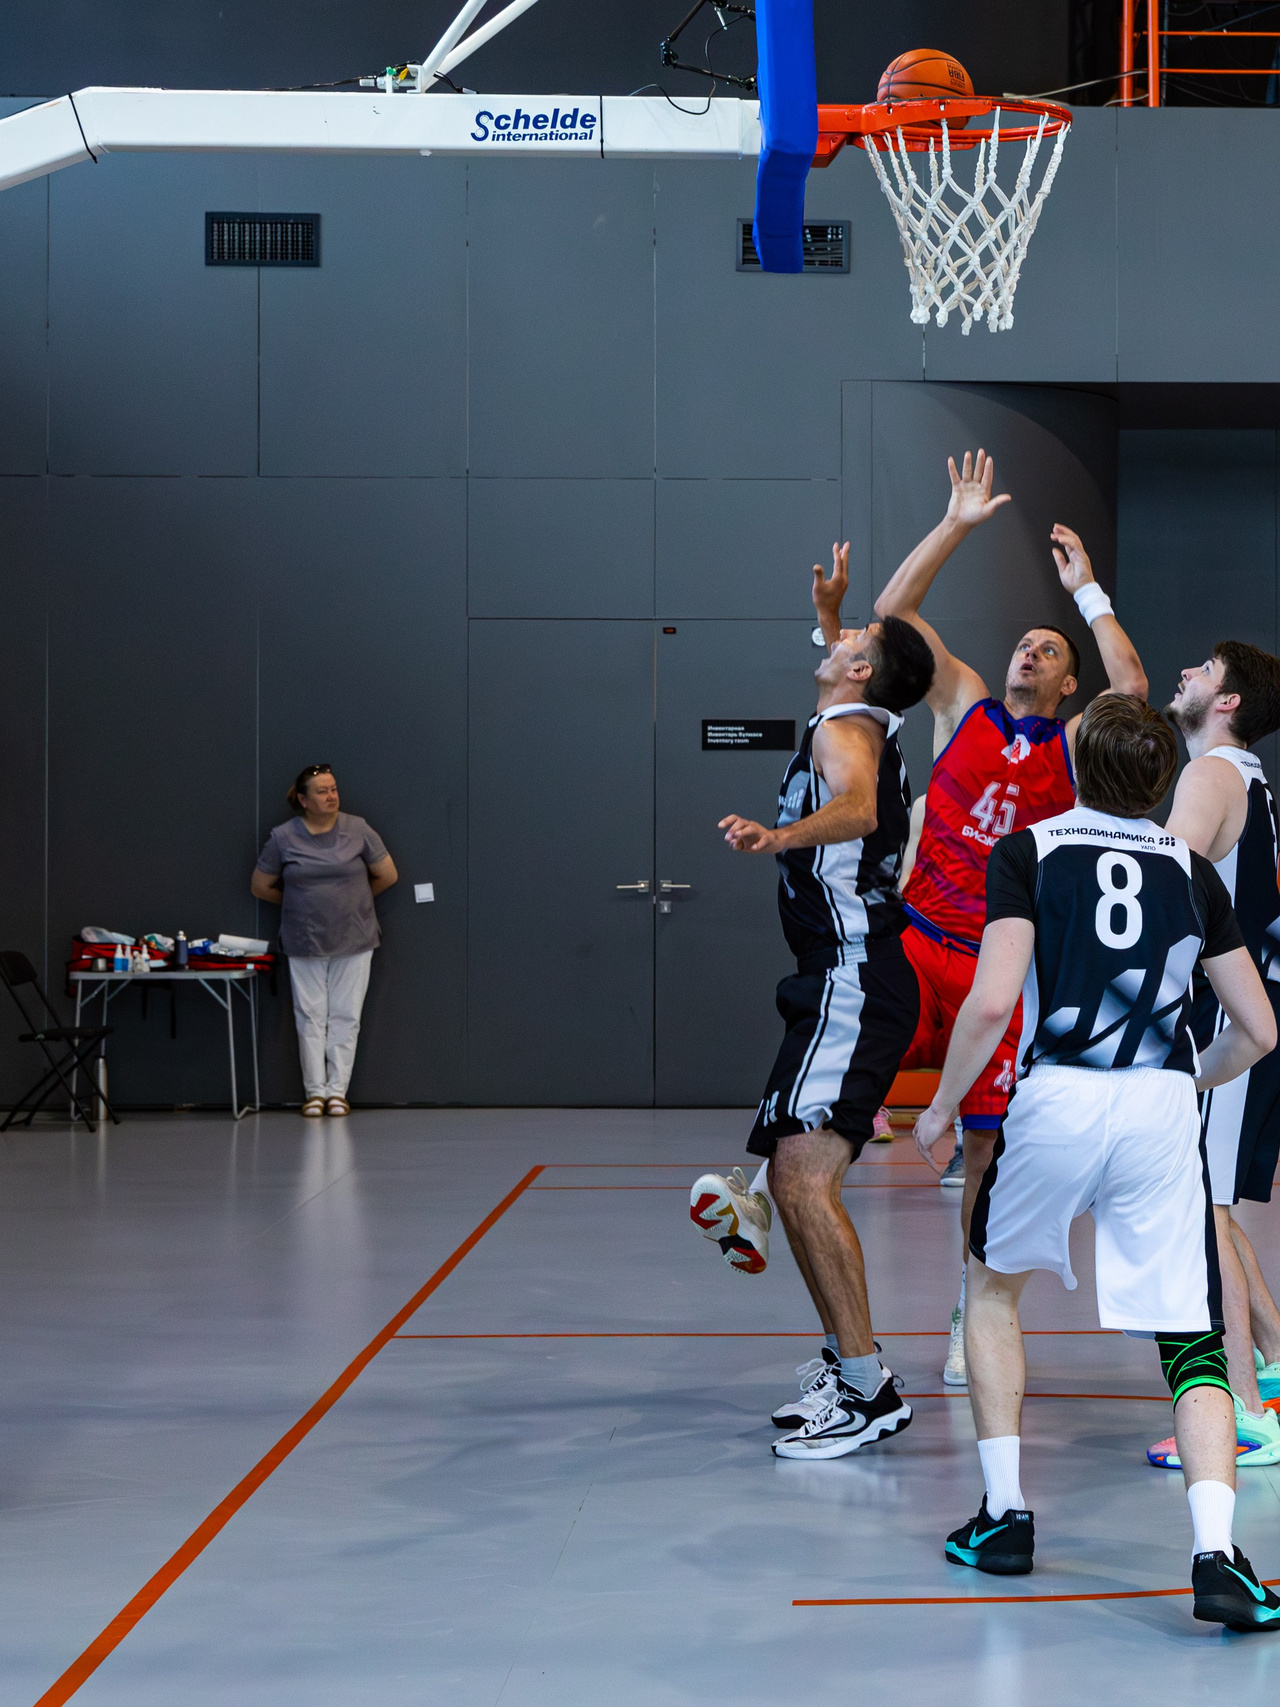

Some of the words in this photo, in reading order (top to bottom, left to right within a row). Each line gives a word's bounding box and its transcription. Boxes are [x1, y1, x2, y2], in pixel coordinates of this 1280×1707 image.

[470, 108, 597, 141] Schelde
[491, 129, 594, 142] international
[969, 781, 1020, 836] 45
[1047, 827, 1155, 844] ТЕХНОДИНАМИКА
[1095, 851, 1143, 950] 8
